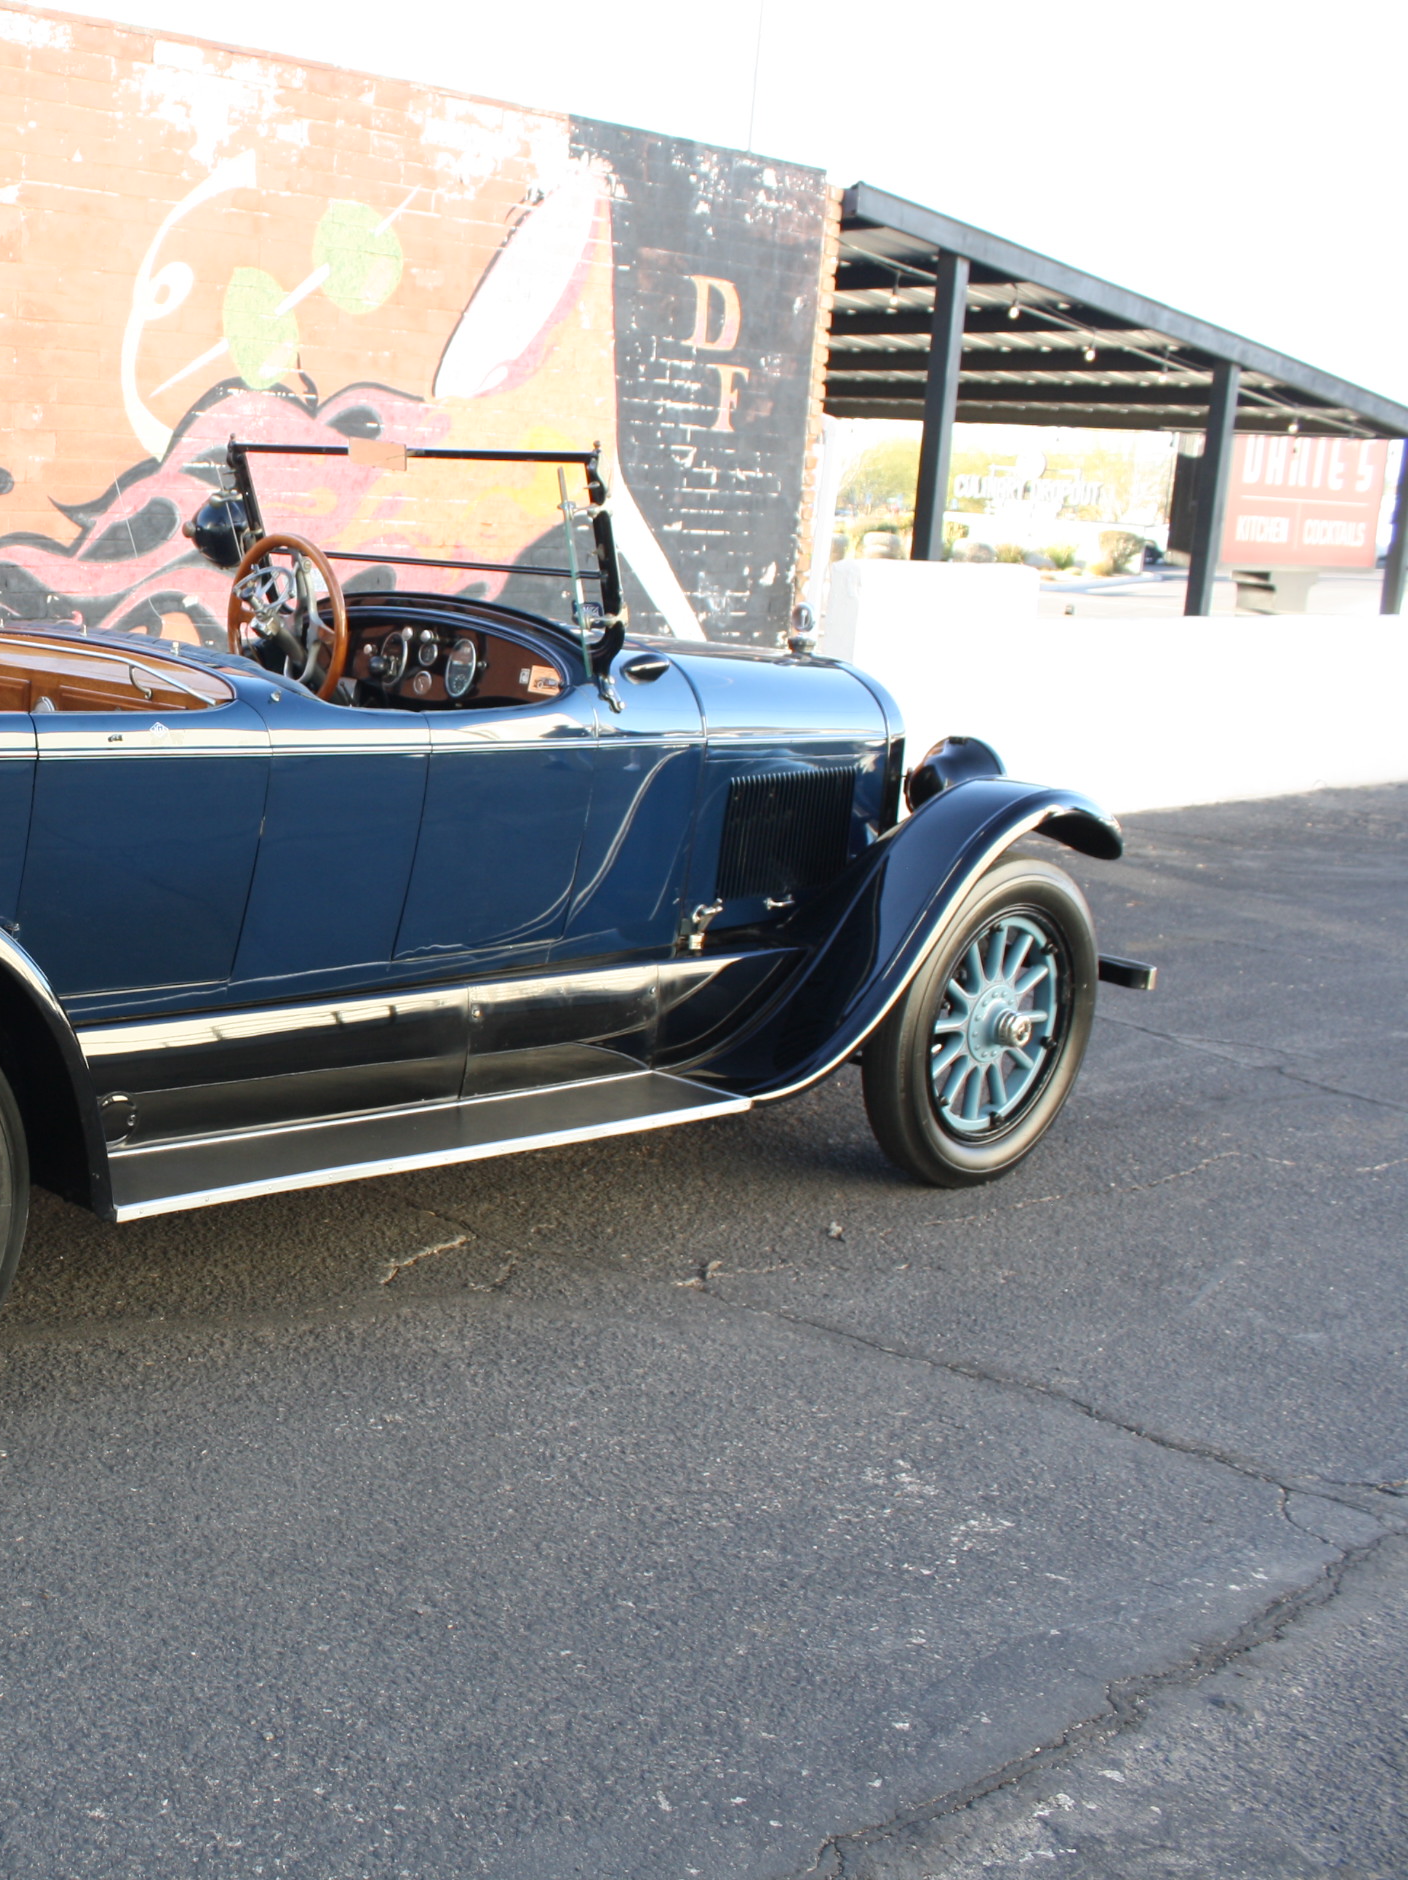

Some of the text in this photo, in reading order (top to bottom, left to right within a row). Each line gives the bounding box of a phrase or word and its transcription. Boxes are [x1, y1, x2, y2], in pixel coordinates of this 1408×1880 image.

[680, 274, 742, 352] D
[709, 364, 751, 433] F
[1235, 515, 1366, 547] KITCHEN COCKTAILS
